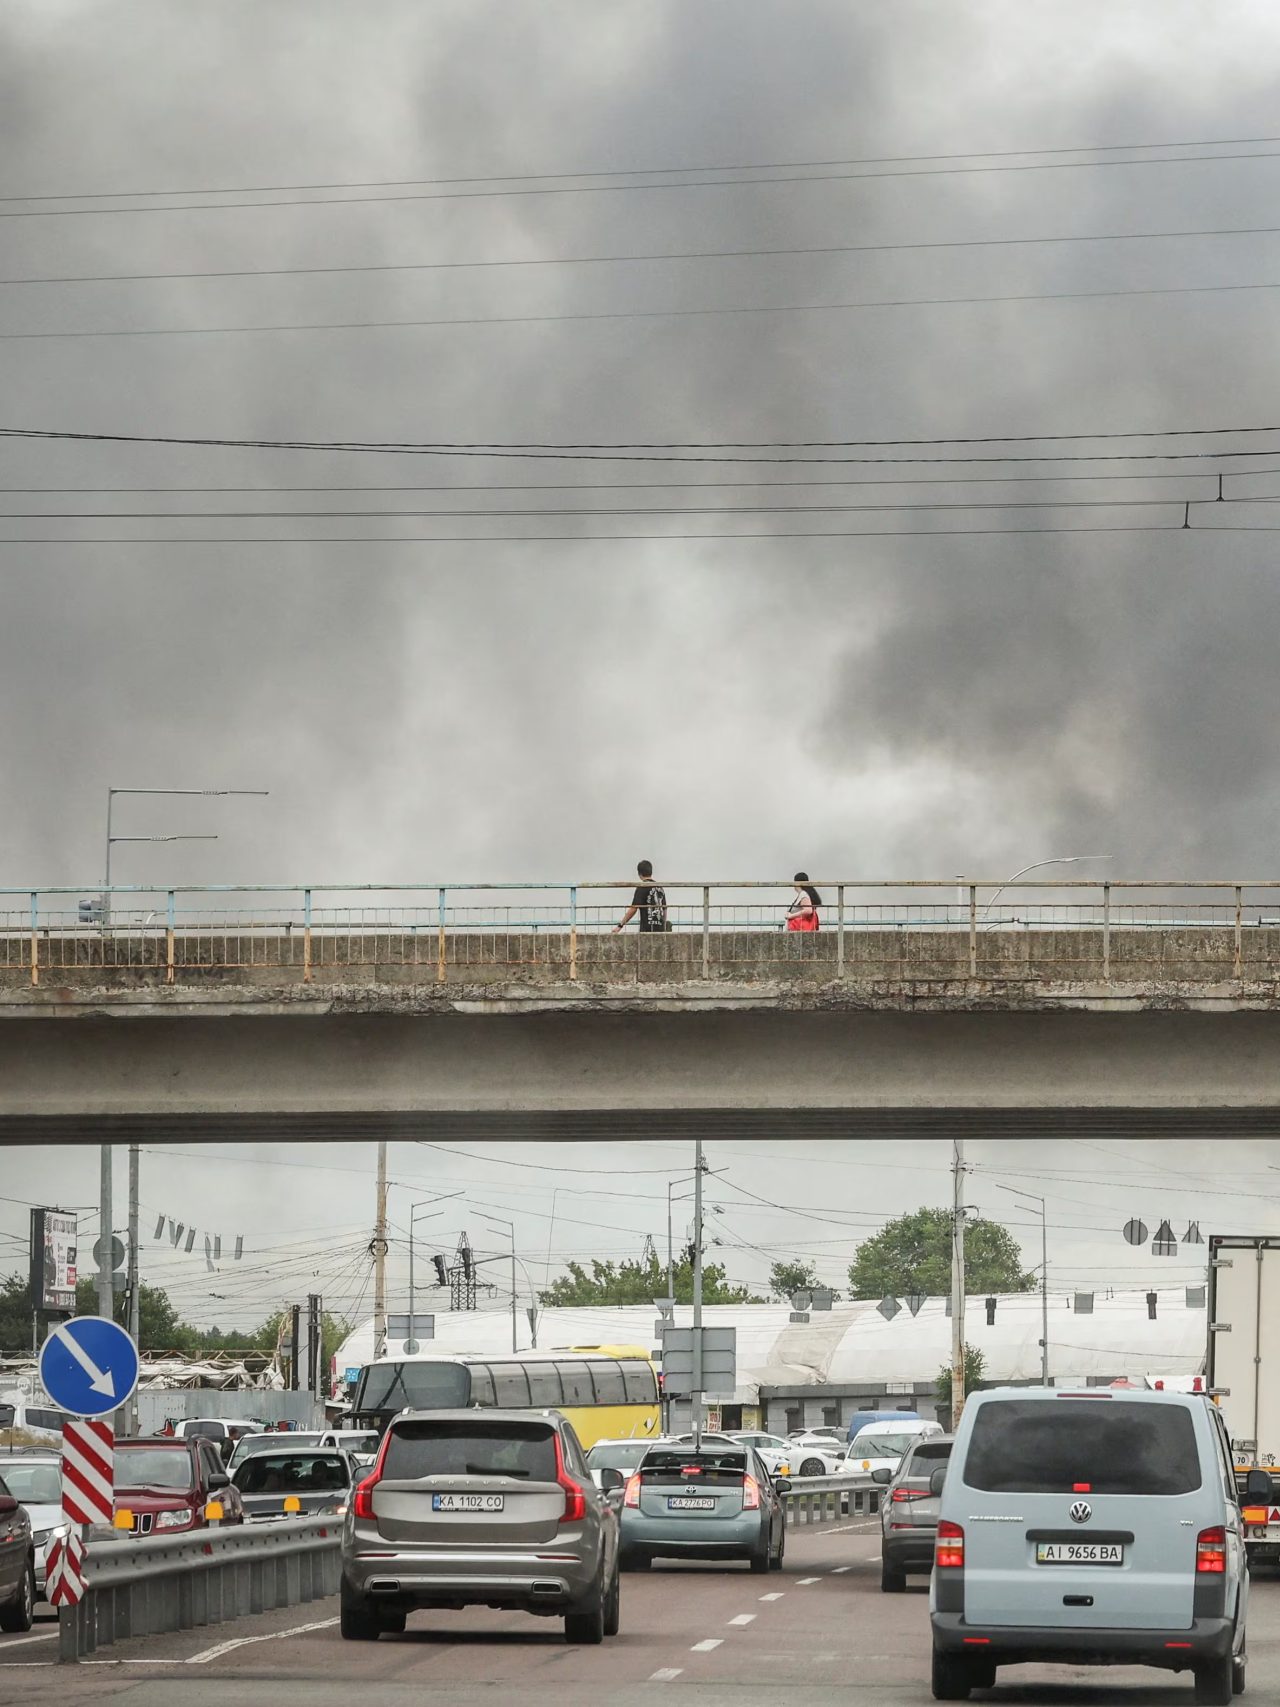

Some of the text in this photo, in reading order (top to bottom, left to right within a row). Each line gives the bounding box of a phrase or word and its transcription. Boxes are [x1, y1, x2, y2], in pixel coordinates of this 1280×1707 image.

[439, 1496, 502, 1508] KA 1102 CO
[672, 1498, 683, 1507] KA
[684, 1498, 701, 1507] 2776
[1046, 1546, 1118, 1560] AI 9656 BA
